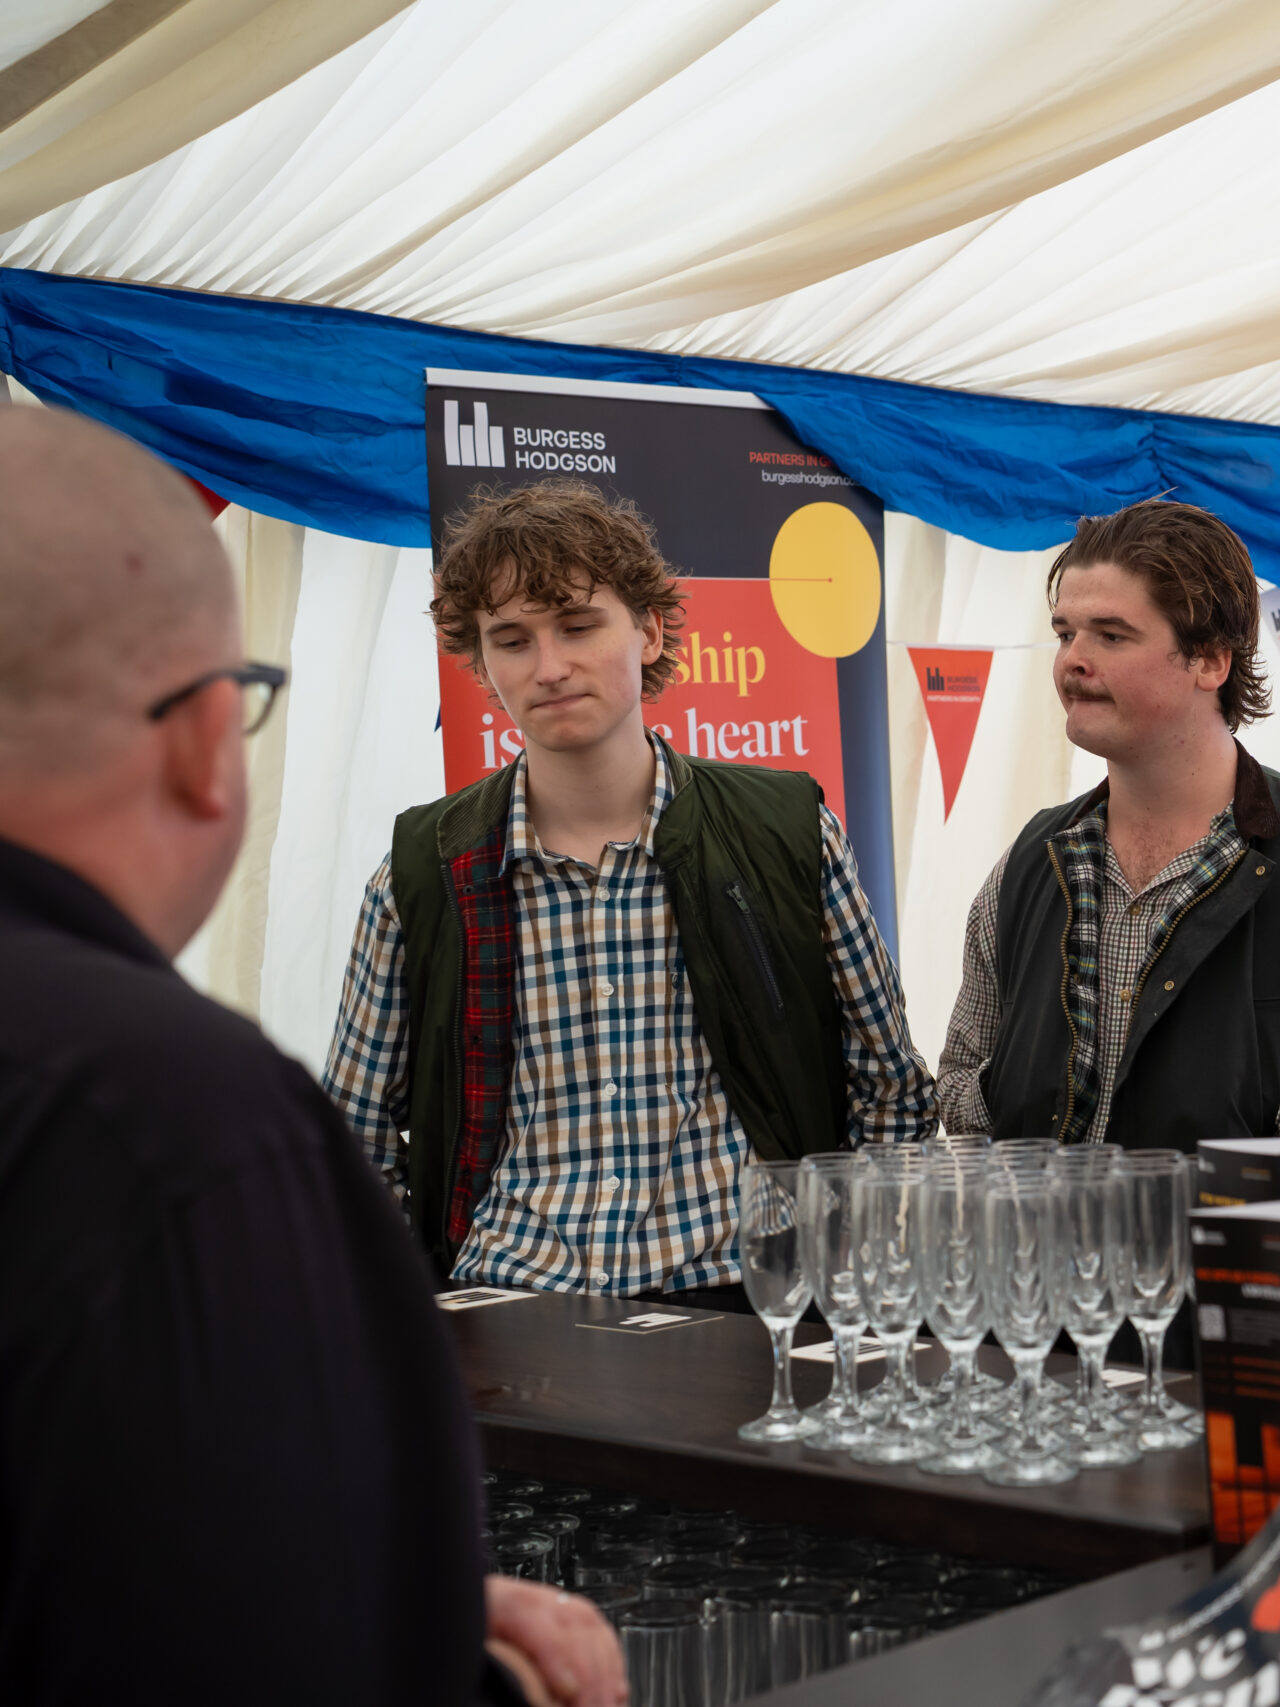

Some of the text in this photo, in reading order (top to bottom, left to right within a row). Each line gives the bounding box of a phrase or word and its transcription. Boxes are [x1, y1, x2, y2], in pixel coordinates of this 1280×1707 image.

[513, 427, 606, 450] BURGESS
[515, 450, 616, 473] HODGSON
[749, 452, 805, 466] PARTNERS
[806, 455, 818, 466] IN
[667, 631, 767, 697] ship
[684, 707, 811, 758] heart
